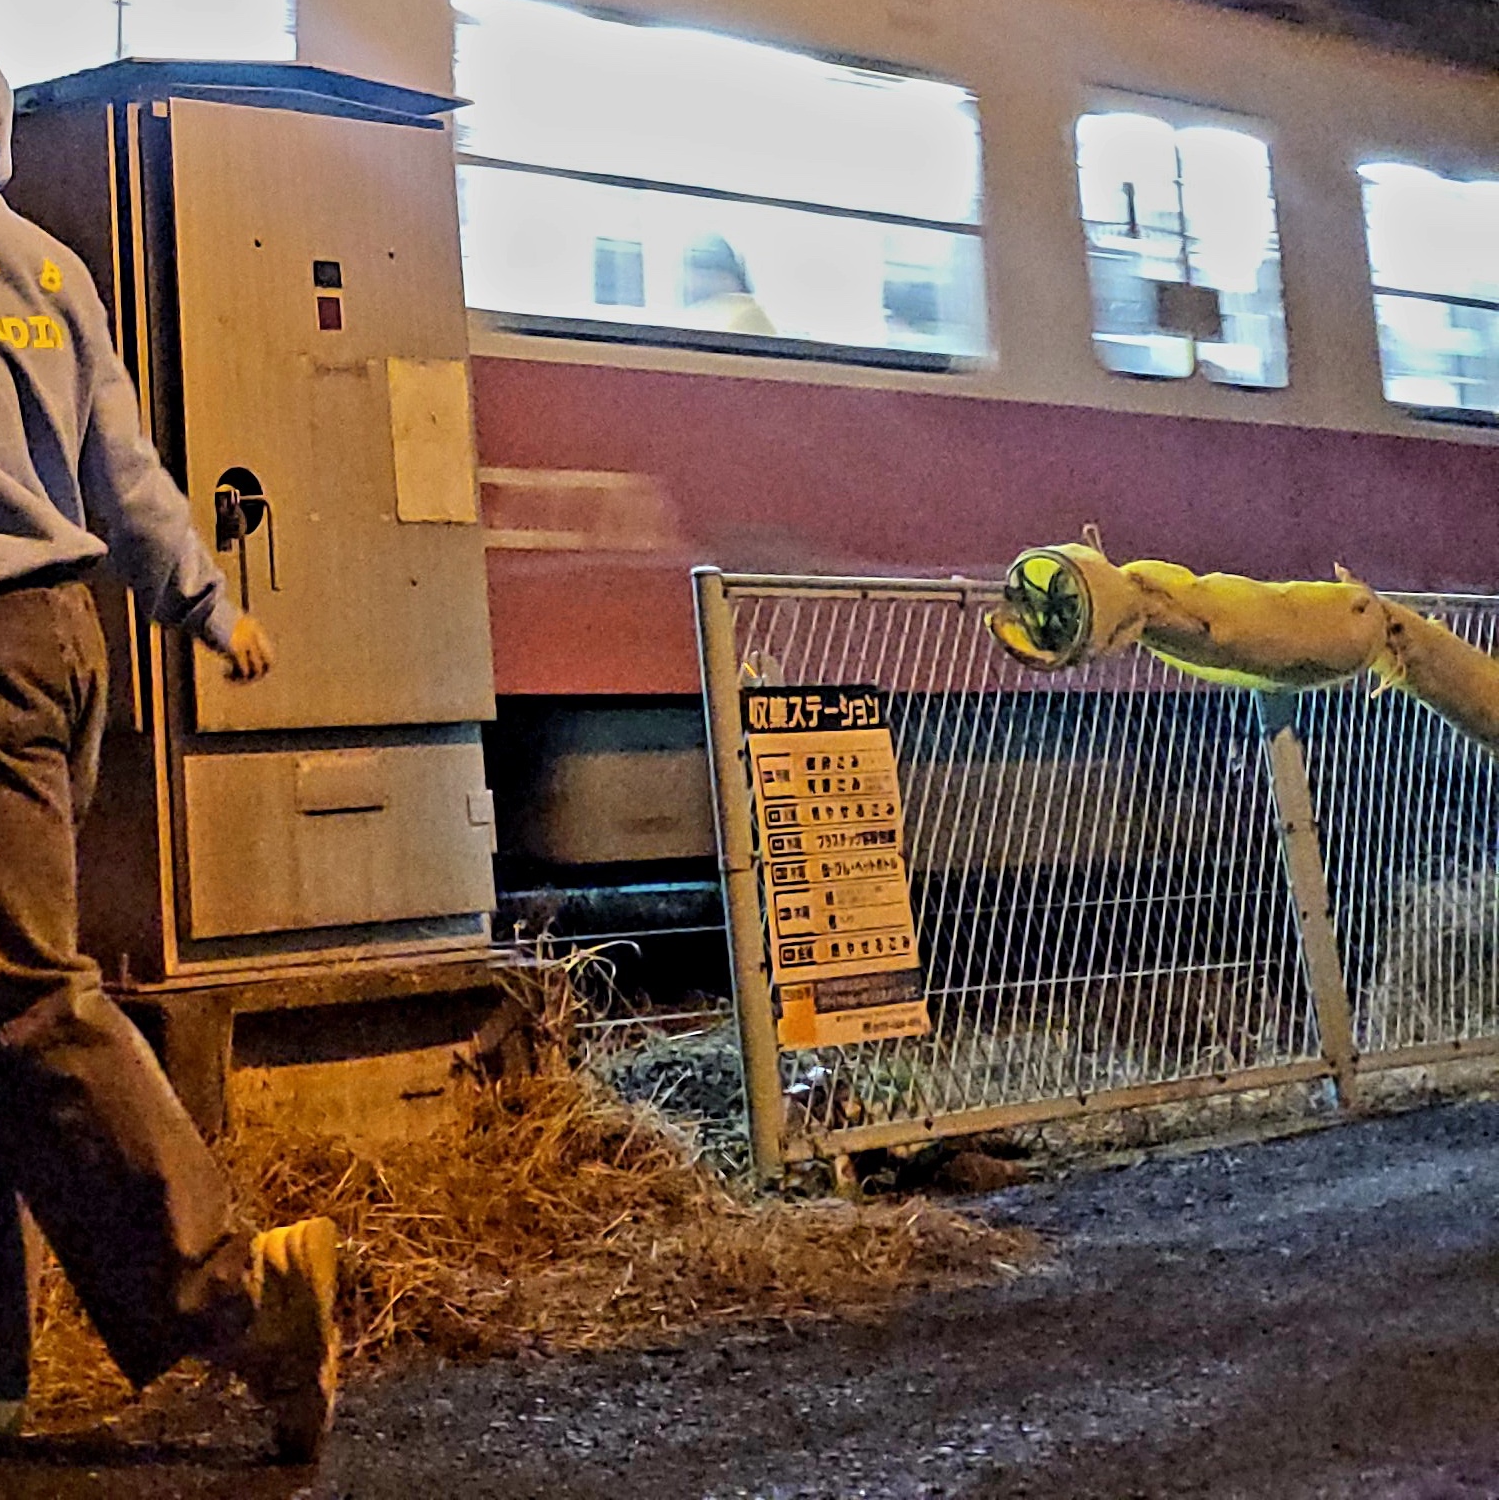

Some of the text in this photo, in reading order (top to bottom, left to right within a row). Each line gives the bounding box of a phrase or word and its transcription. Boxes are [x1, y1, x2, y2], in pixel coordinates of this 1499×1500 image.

[748, 692, 880, 730] 収集ステーション
